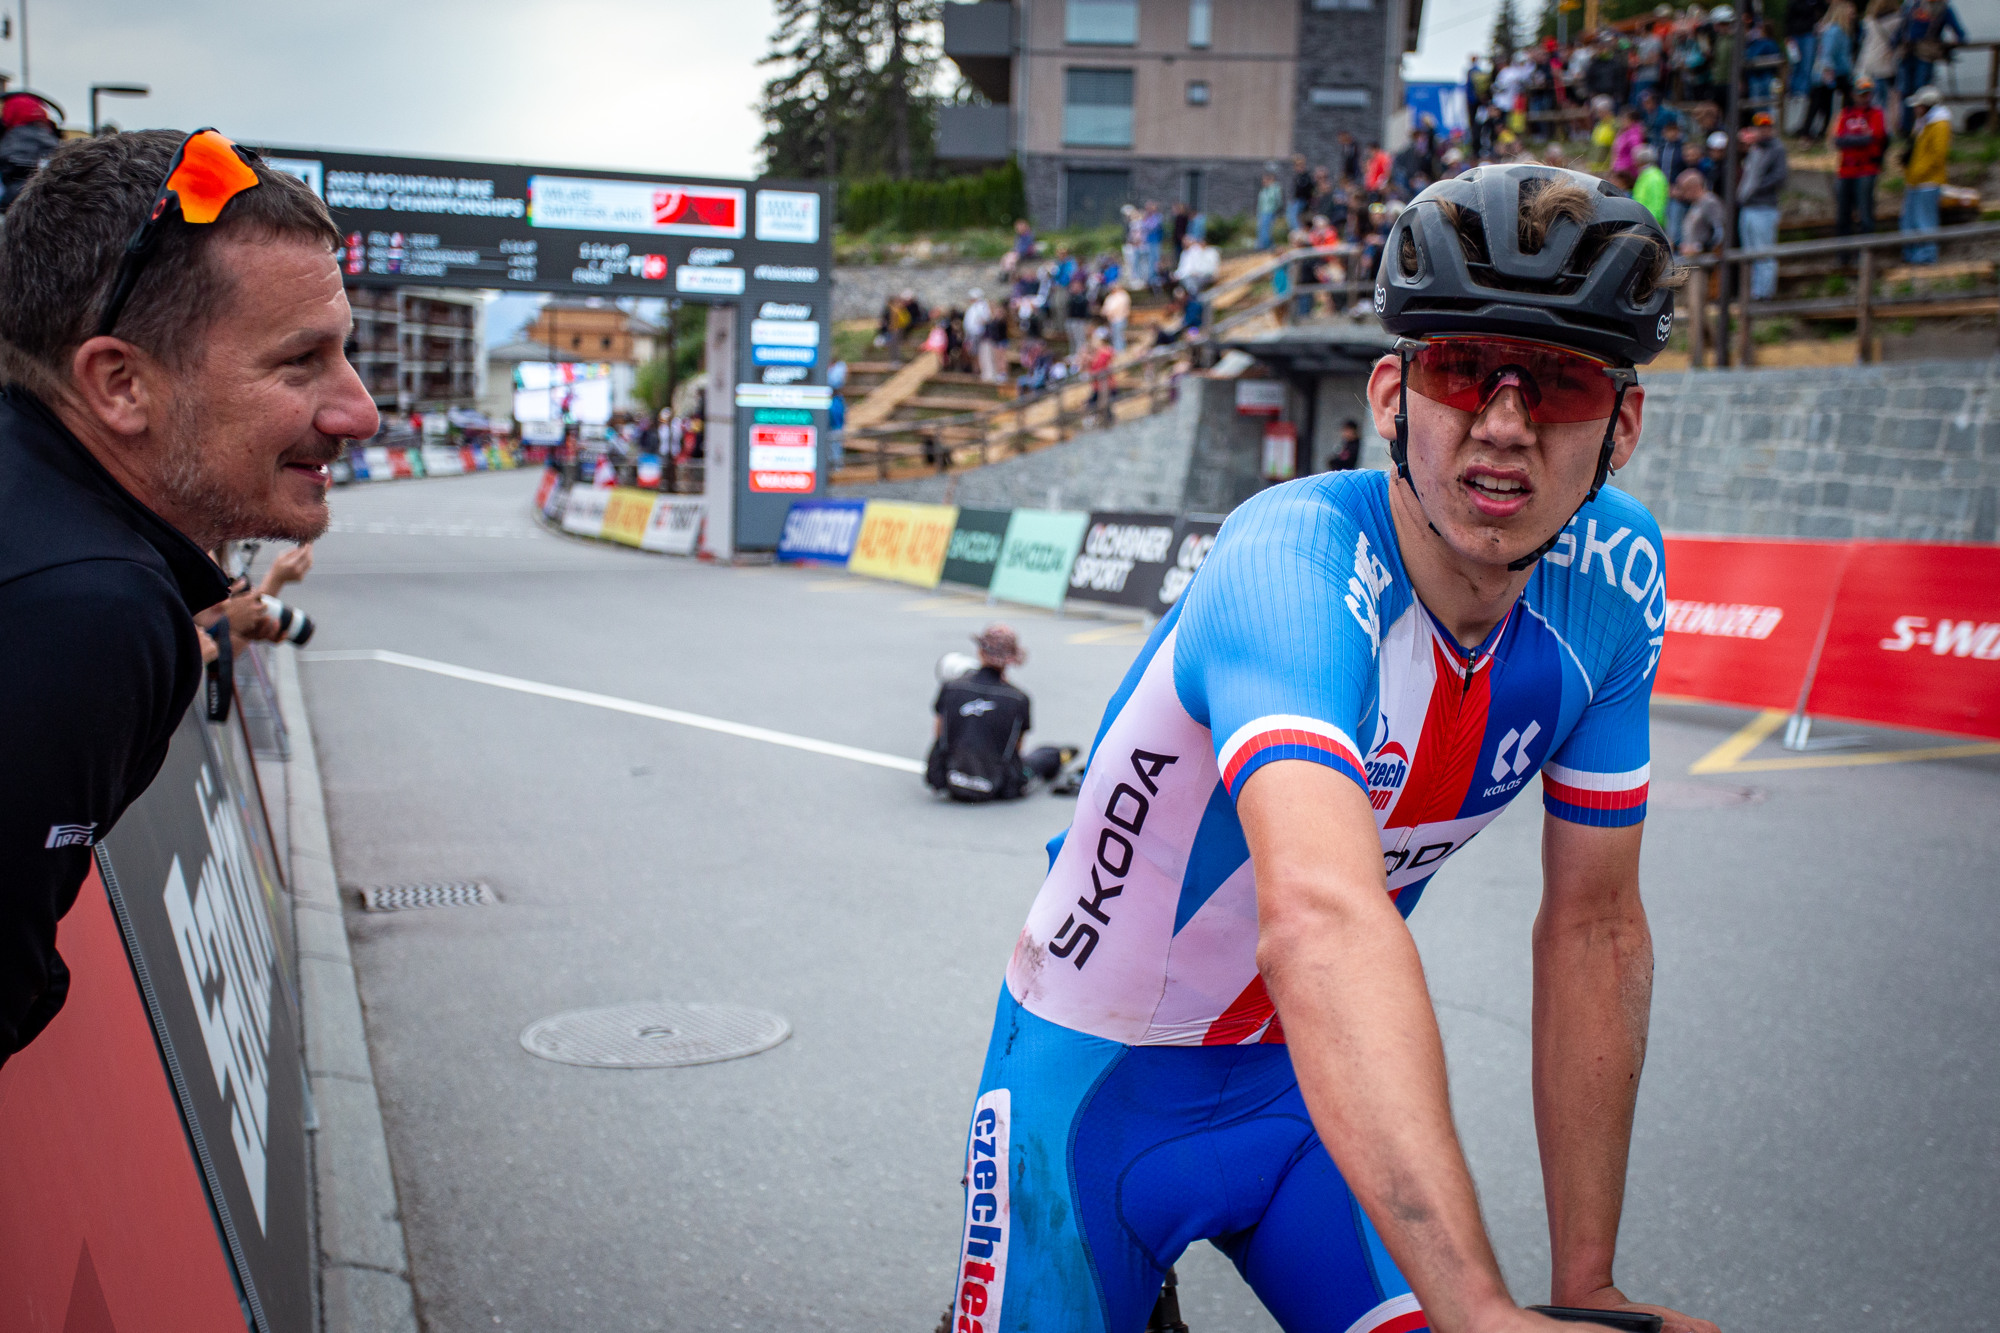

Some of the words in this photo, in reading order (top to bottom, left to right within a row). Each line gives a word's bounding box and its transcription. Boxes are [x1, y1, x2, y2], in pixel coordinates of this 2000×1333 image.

[326, 190, 389, 210] WORLD
[389, 192, 525, 218] CHAMPIONSHIPS
[1069, 554, 1135, 592] SPORT
[44, 822, 98, 849] PIREL
